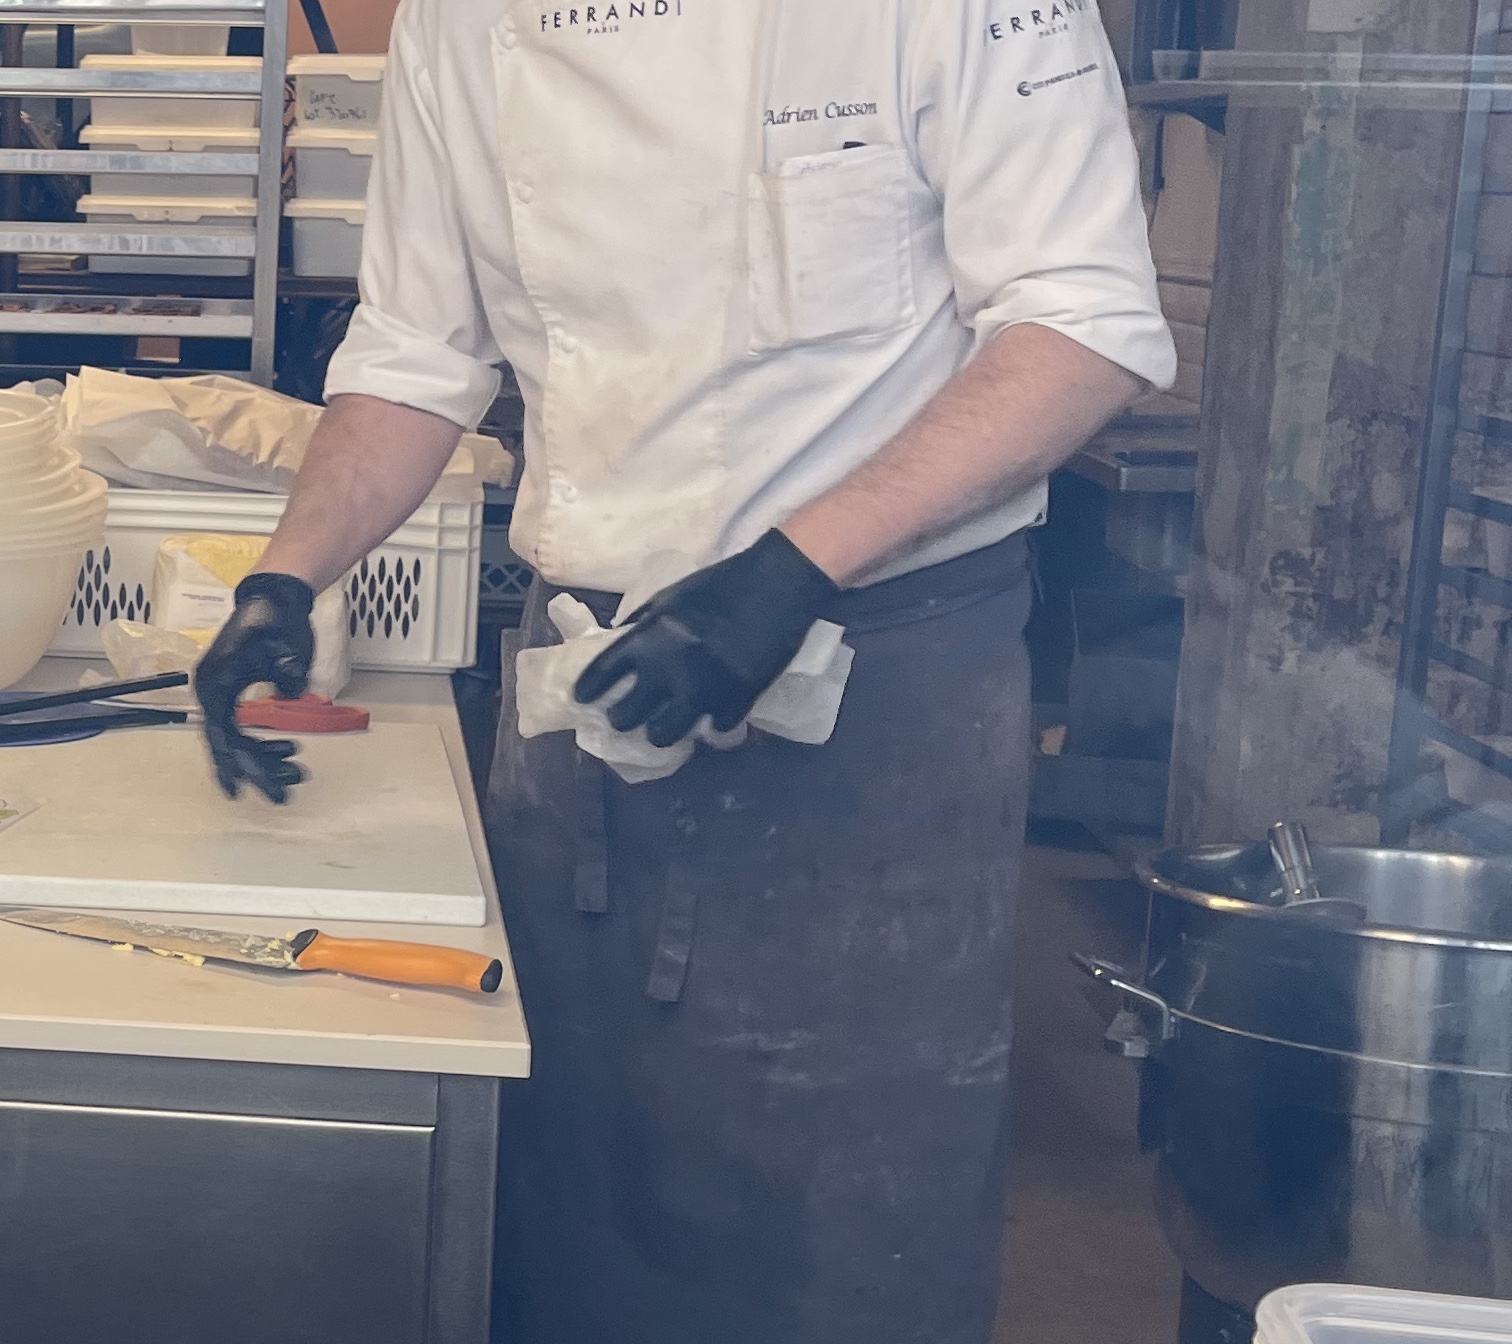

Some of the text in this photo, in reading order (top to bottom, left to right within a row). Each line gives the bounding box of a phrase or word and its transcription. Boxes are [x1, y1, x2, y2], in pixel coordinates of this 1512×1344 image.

[586, 25, 620, 35] PARIS
[762, 101, 878, 127] Adrien Cusson
